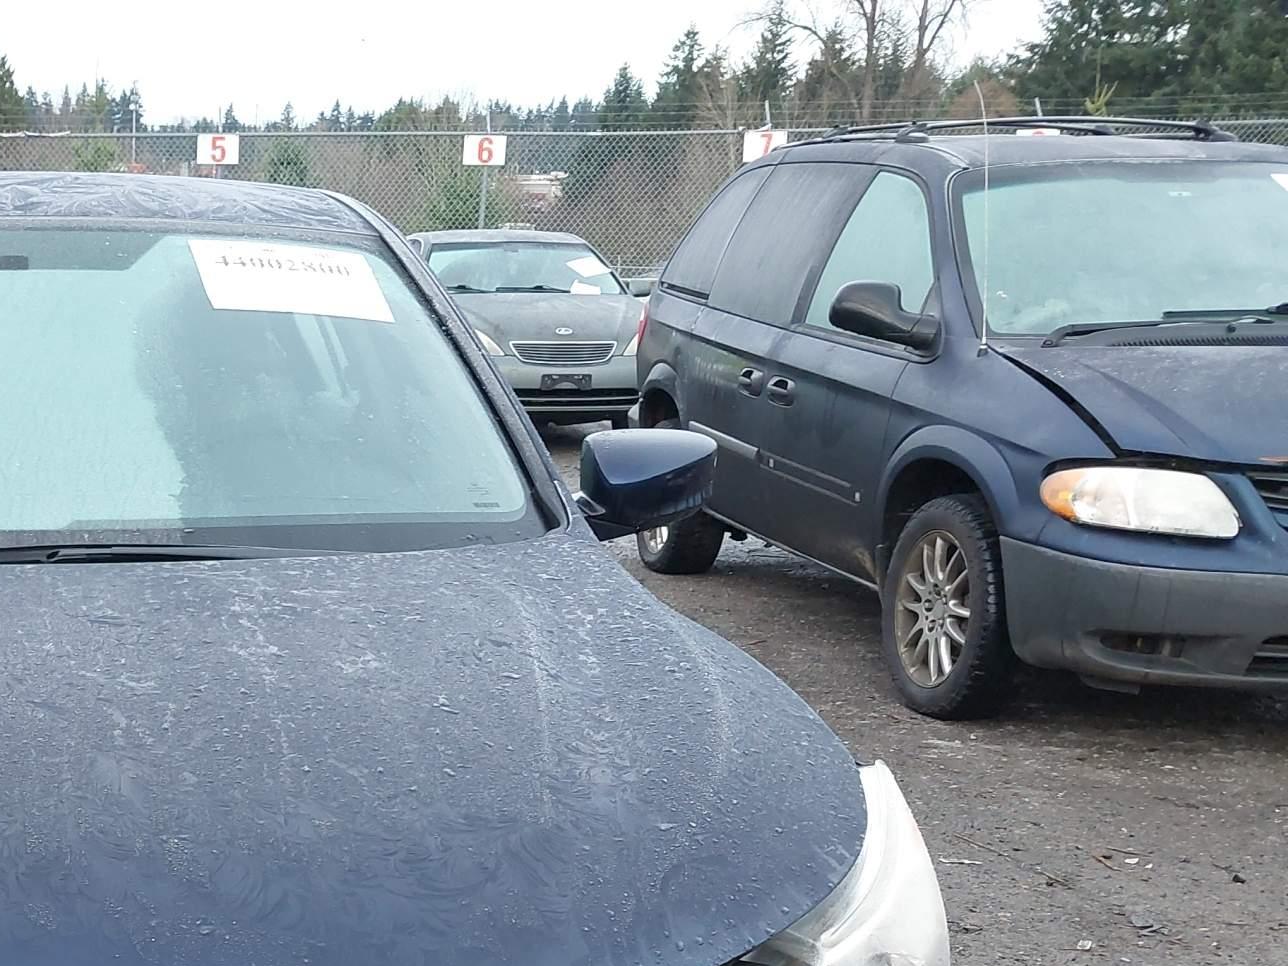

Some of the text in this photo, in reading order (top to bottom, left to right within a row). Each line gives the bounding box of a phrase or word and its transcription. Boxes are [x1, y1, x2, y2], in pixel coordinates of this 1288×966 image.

[211, 136, 226, 163] 5
[477, 137, 493, 164] 6
[760, 133, 773, 155] 7
